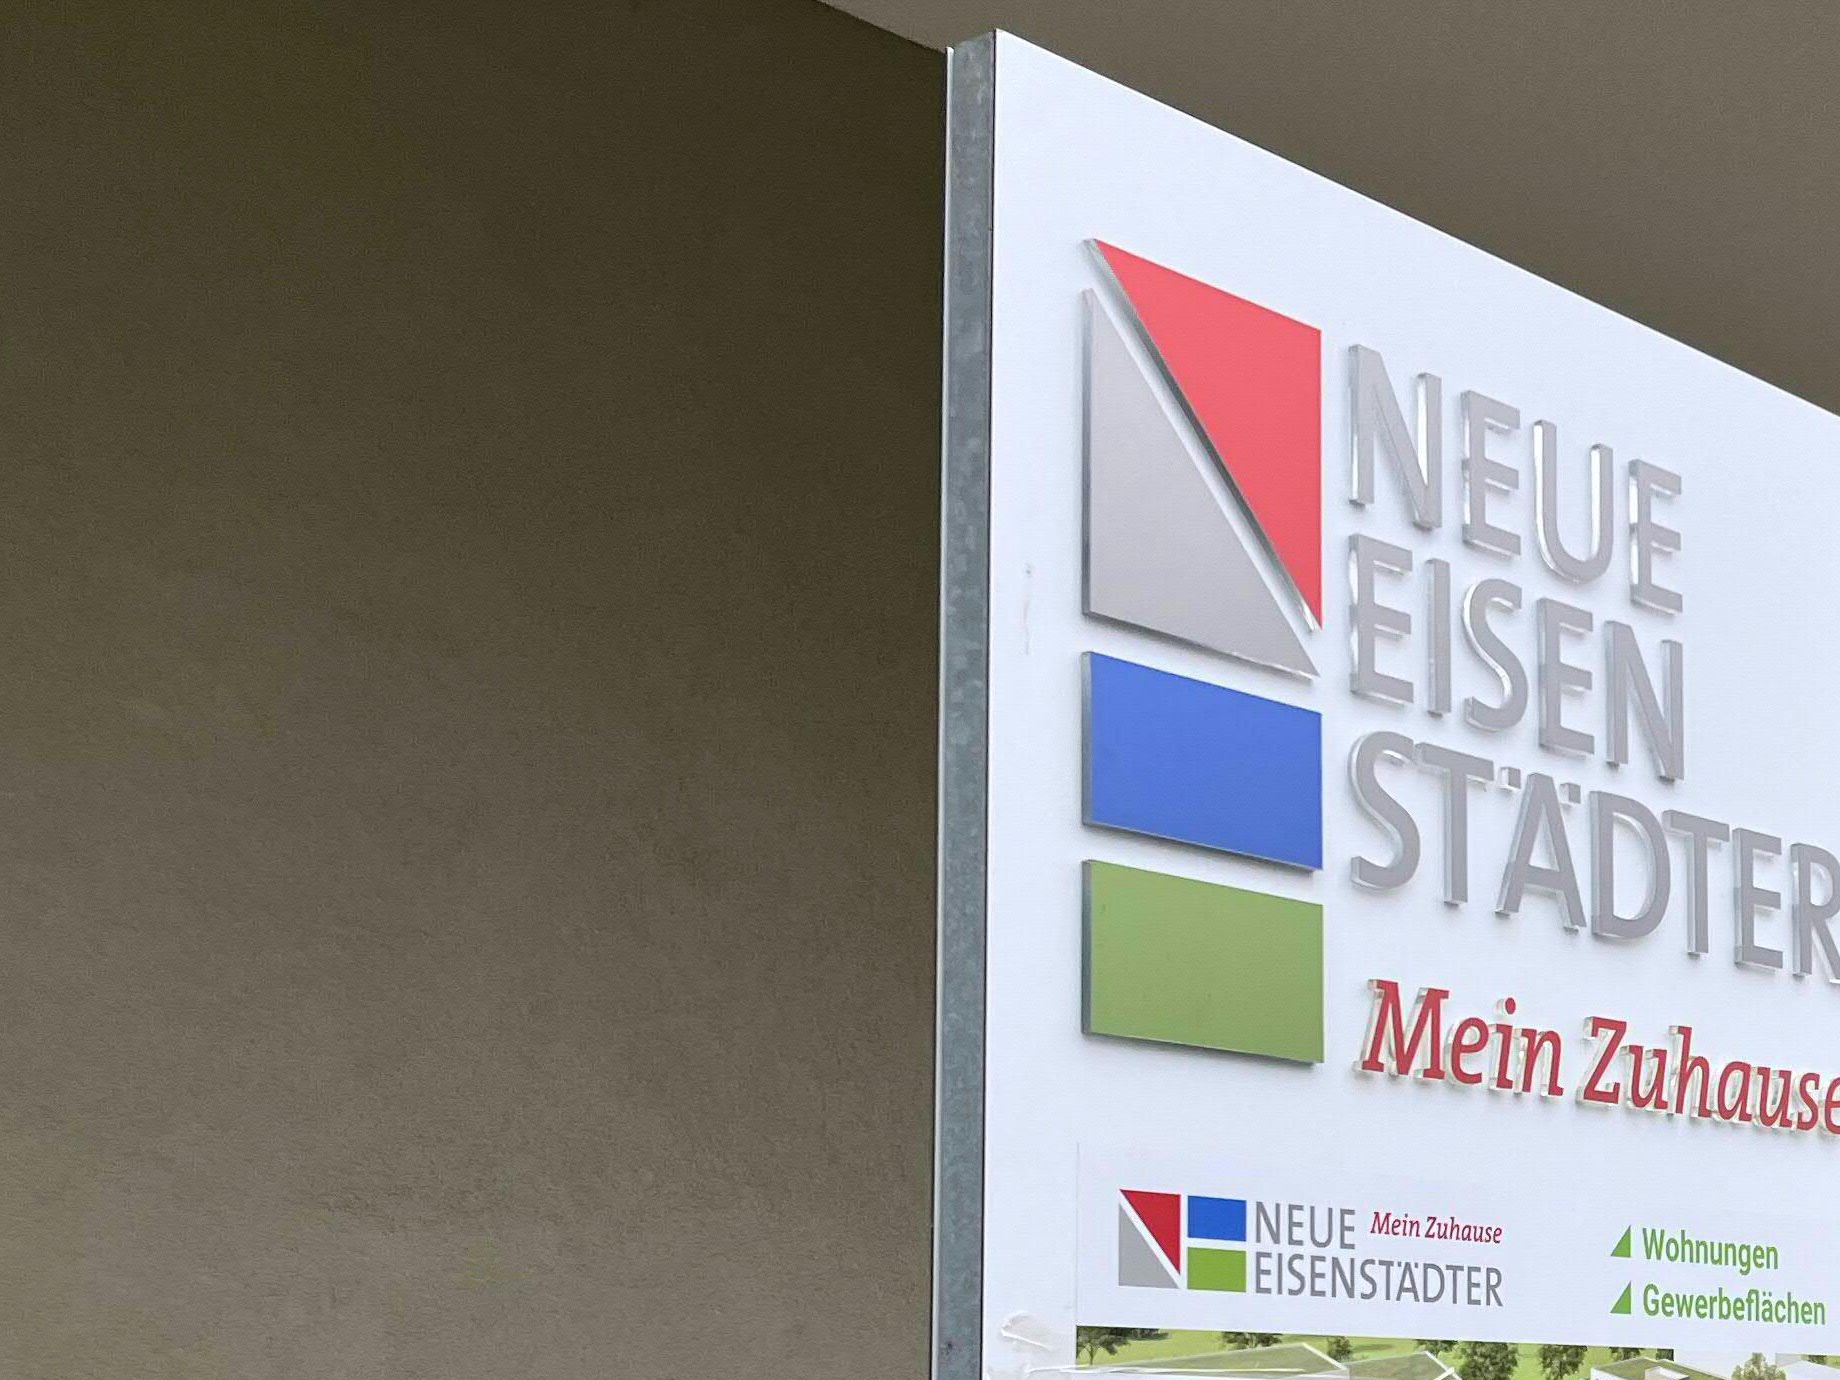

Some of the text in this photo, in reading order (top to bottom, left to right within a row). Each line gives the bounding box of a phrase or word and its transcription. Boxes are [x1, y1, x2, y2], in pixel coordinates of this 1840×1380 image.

[1348, 343, 1684, 614] NEUE
[1348, 533, 1684, 783] EISEN
[1358, 977, 1564, 1100] Mein
[1255, 1201, 1356, 1251] NEUE
[1370, 1211, 1503, 1245] Mein Zuhause
[1642, 1227, 1779, 1275] Wohnungen
[1255, 1253, 1504, 1308] EISENSTÄDTER
[1643, 1284, 1826, 1327] Gewerbeflächen
